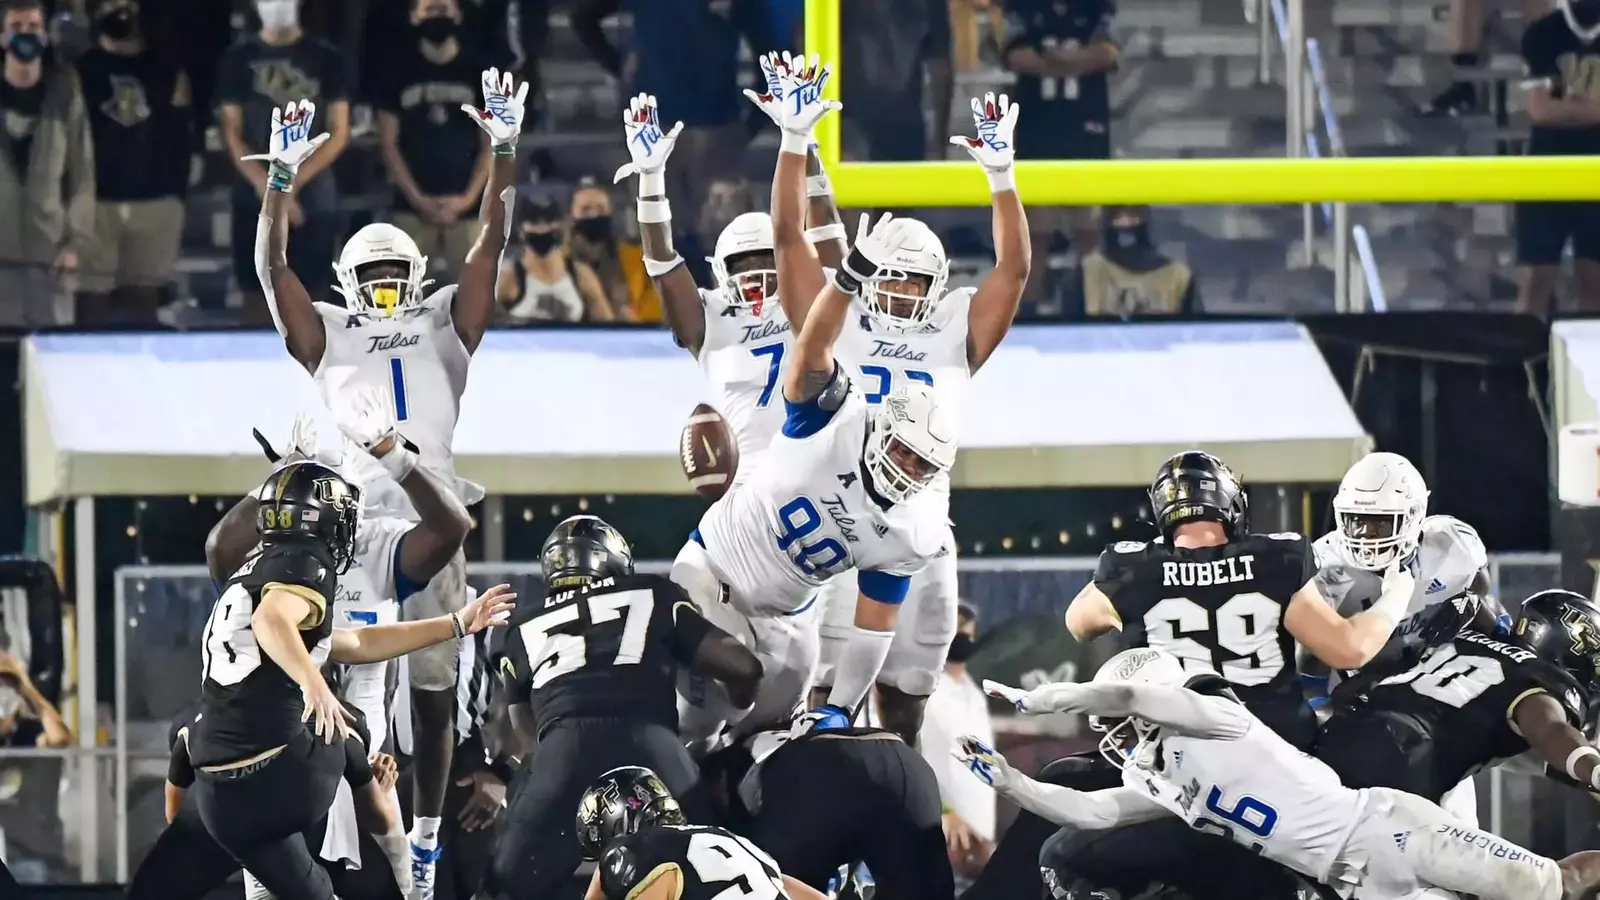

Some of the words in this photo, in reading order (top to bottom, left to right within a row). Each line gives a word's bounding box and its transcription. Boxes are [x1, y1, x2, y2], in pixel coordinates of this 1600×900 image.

[367, 332, 420, 354] Tulsa
[738, 320, 791, 344] Tulsa
[869, 340, 928, 362] Tulsa
[390, 357, 408, 422] 1
[750, 342, 785, 407] 7
[264, 508, 292, 530] 98
[776, 496, 849, 576] 90
[820, 493, 860, 544] Tulsa
[1162, 555, 1255, 586] RUBELT
[519, 588, 654, 689] 57
[1143, 592, 1285, 687] 69
[1437, 823, 1545, 871] HURRICANE
